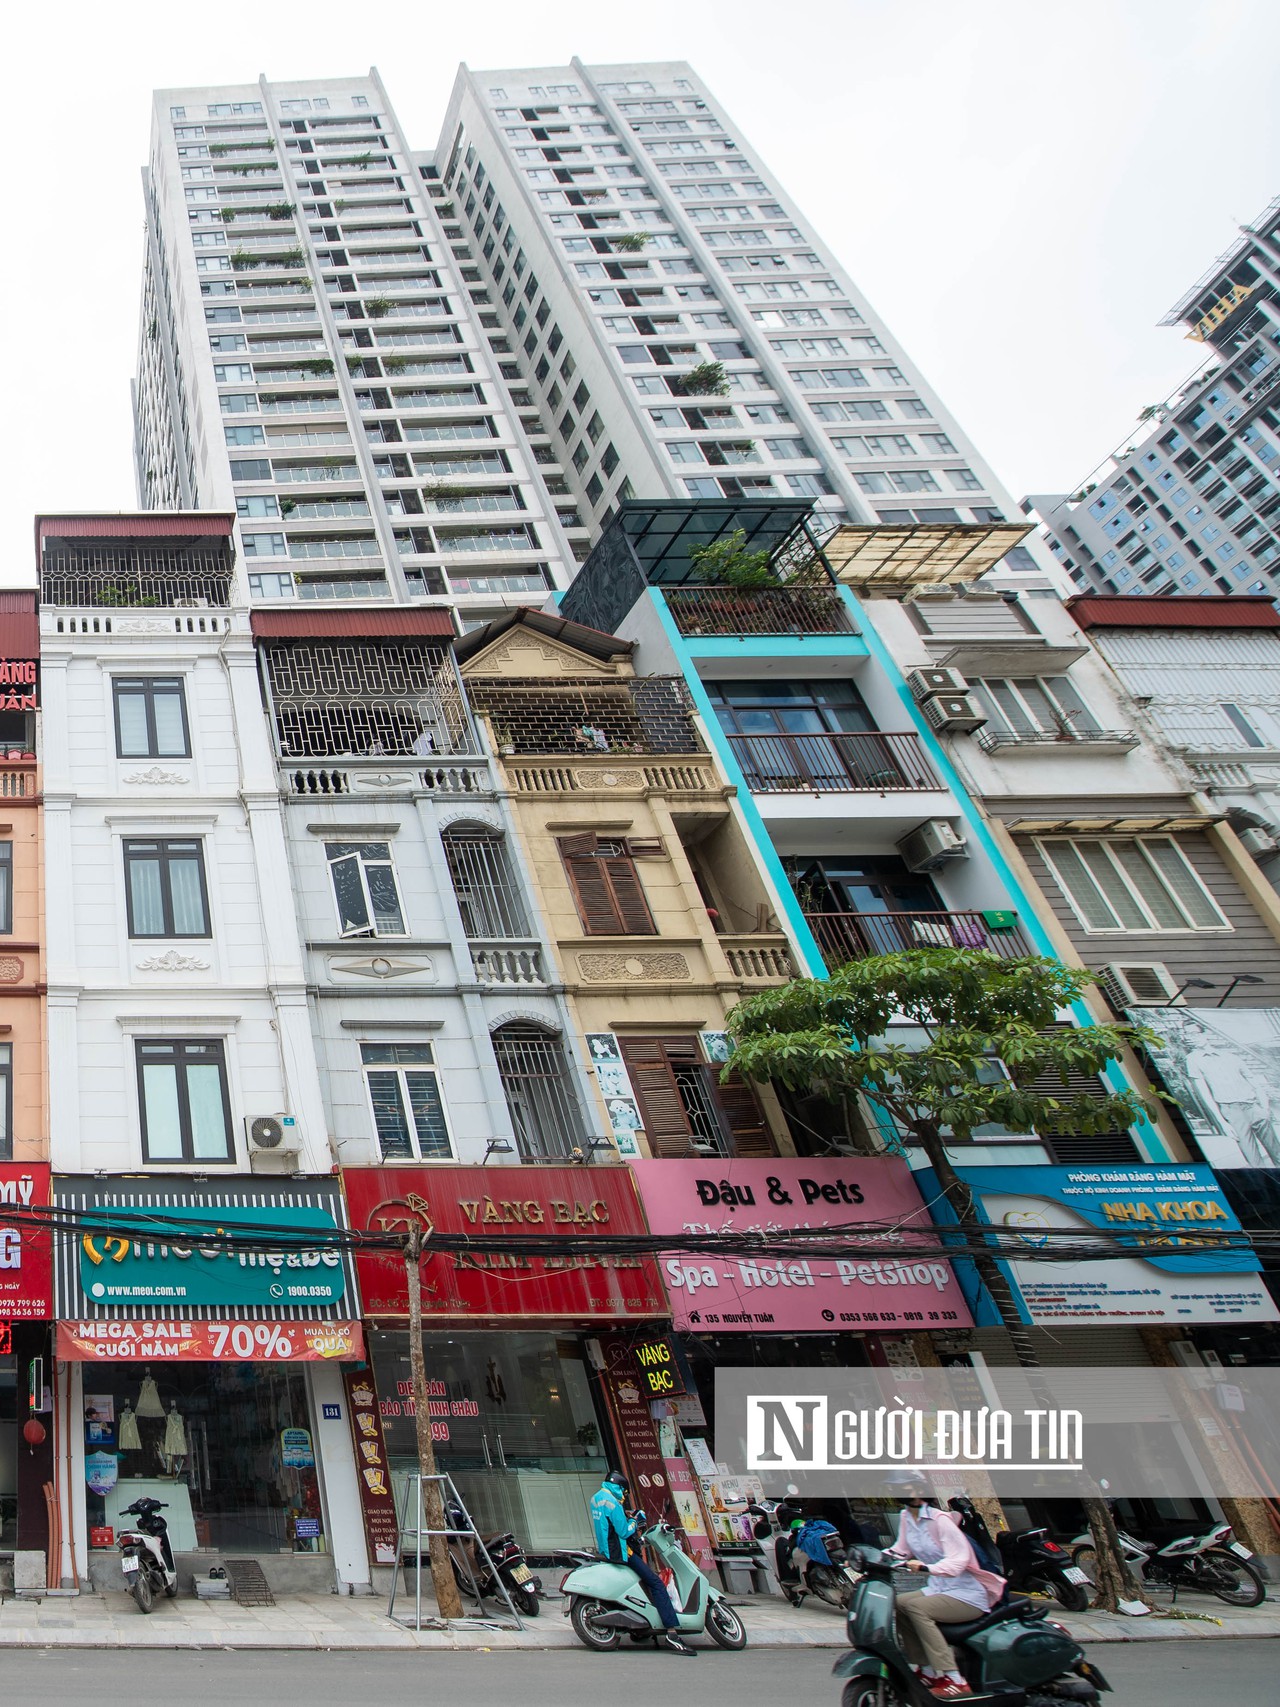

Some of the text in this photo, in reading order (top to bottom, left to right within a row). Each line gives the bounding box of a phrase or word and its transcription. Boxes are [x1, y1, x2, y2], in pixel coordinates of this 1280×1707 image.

[1068, 1170, 1196, 1183] PHÒNG KHÁM RĂNG HÀM MẶT
[695, 1176, 864, 1212] Đậu & Pets
[459, 1195, 610, 1228] VÀNG BẠC
[1101, 1200, 1228, 1223] NHA KHOA
[666, 1259, 949, 1295] Spa Hotel Petshop
[287, 1285, 332, 1296] 1900.0350
[12, 1308, 21, 1316] 36
[22, 1308, 32, 1316] 36
[33, 1308, 45, 1316] 159
[704, 1313, 719, 1323] 135
[840, 1312, 861, 1322] 0353
[943, 1310, 958, 1320] 333
[79, 1323, 193, 1338] MEGA SALE
[304, 1327, 351, 1336] MUA LÀ CÓ
[95, 1337, 179, 1357] CUỐI NĂM
[208, 1324, 292, 1358] 70%
[313, 1334, 348, 1351] QUÀ
[636, 1343, 670, 1366] VÀNG
[647, 1370, 673, 1393] BẠC
[325, 1407, 338, 1417] 131
[451, 1398, 479, 1417] CHÂU
[722, 1479, 739, 1489] MENU
